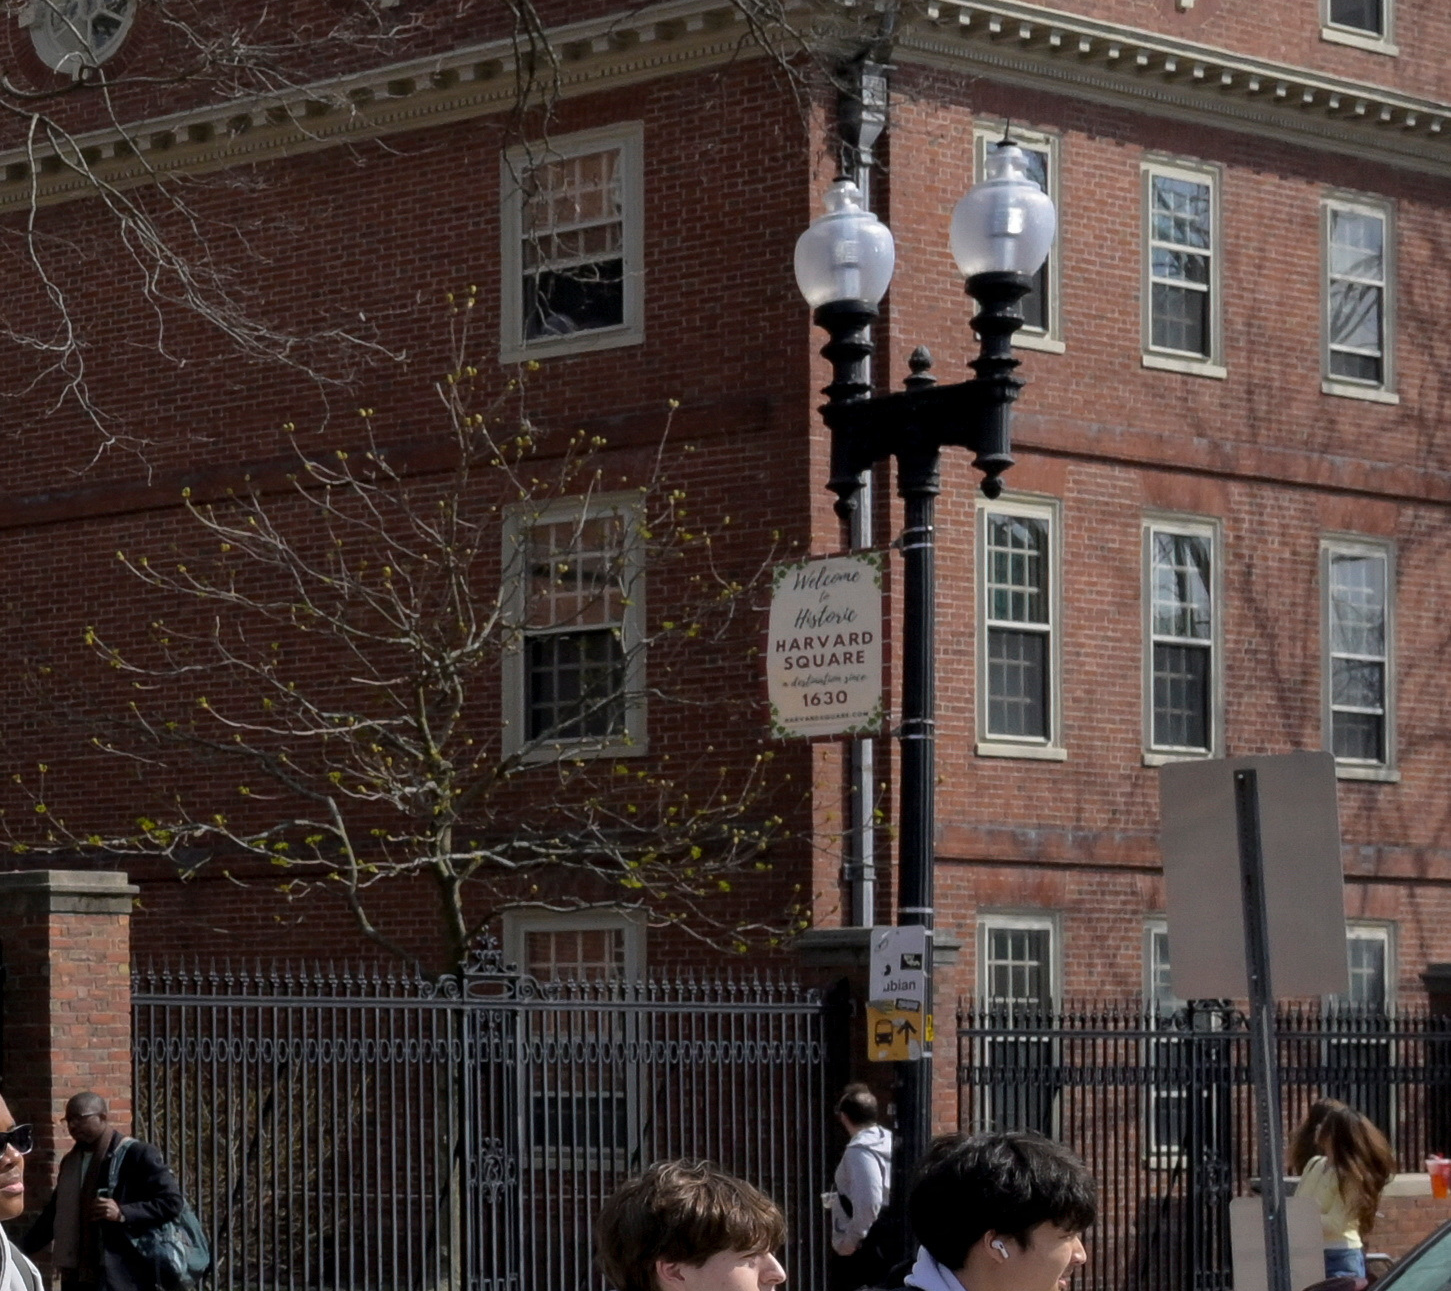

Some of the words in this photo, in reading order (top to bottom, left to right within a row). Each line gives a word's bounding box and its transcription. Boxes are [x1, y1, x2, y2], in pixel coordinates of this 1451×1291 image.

[793, 566, 860, 590] Welcome
[818, 590, 830, 603] to
[794, 605, 858, 629] Historic
[776, 631, 874, 653] HARVARD
[783, 650, 865, 671] SQUARE
[802, 690, 848, 707] 1630
